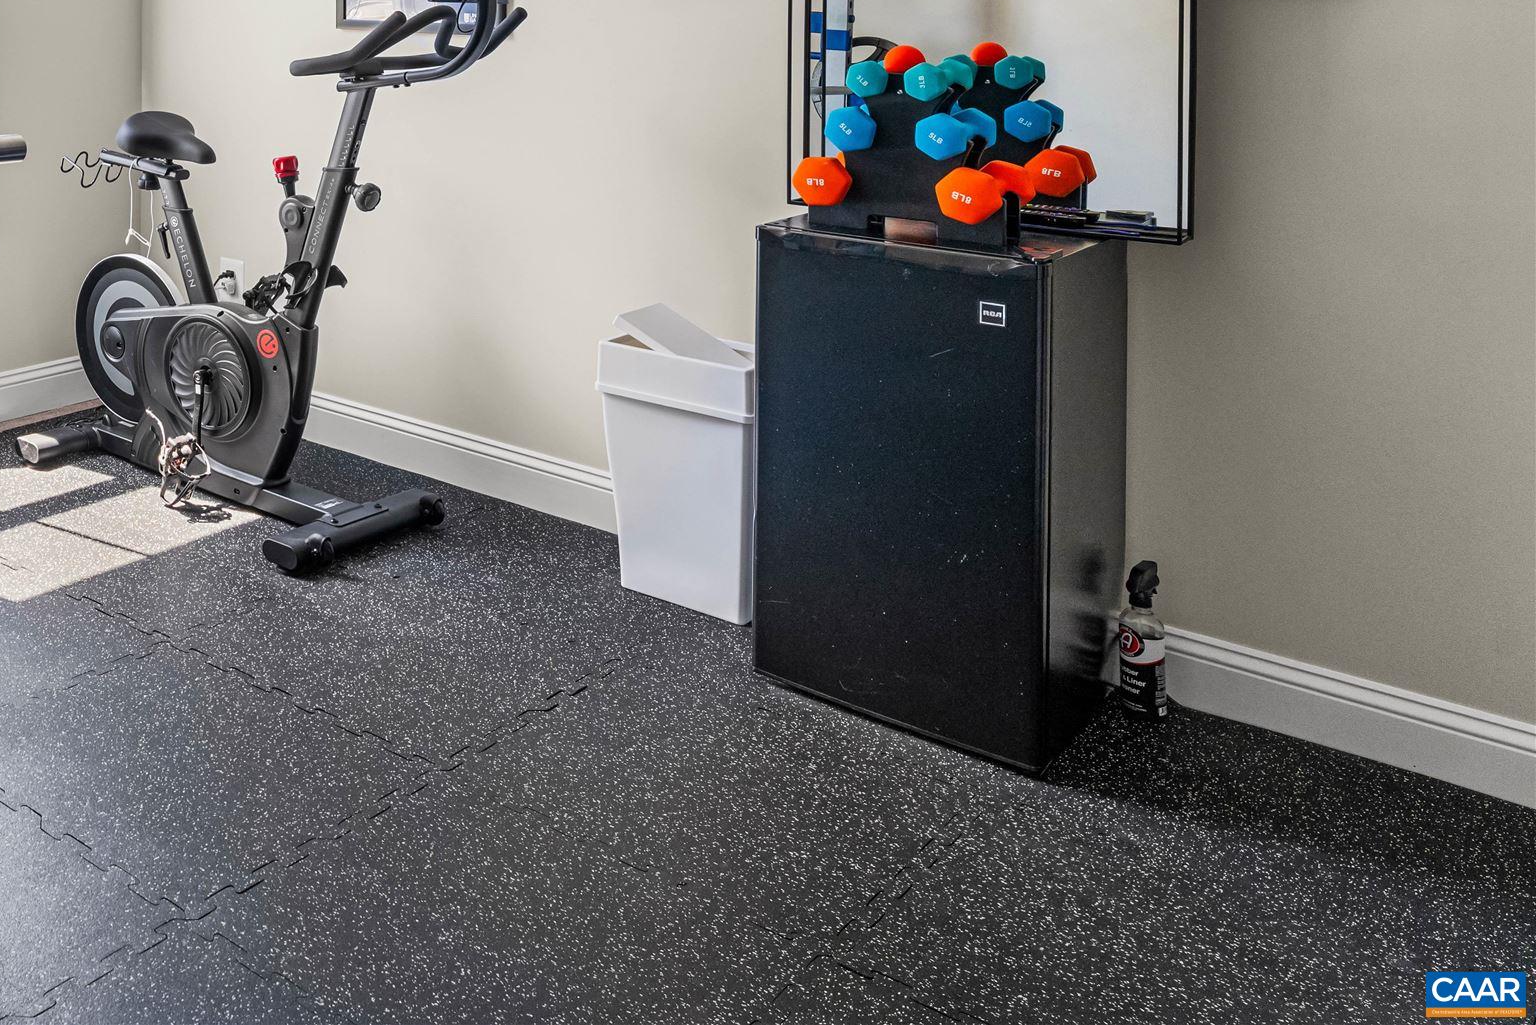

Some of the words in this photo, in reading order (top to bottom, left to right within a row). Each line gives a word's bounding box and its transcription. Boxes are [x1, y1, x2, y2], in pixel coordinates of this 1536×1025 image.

[855, 75, 869, 87] 3LB
[918, 75, 926, 89] 3LB
[839, 122, 853, 136] 5LB
[928, 132, 944, 145] 5LB
[806, 178, 825, 186] 8LB
[951, 191, 972, 205] 8LB
[308, 201, 329, 255] CONNECT
[173, 229, 197, 289] ECHELON
[983, 309, 1002, 318] RCA
[1126, 675, 1147, 687] Liner
